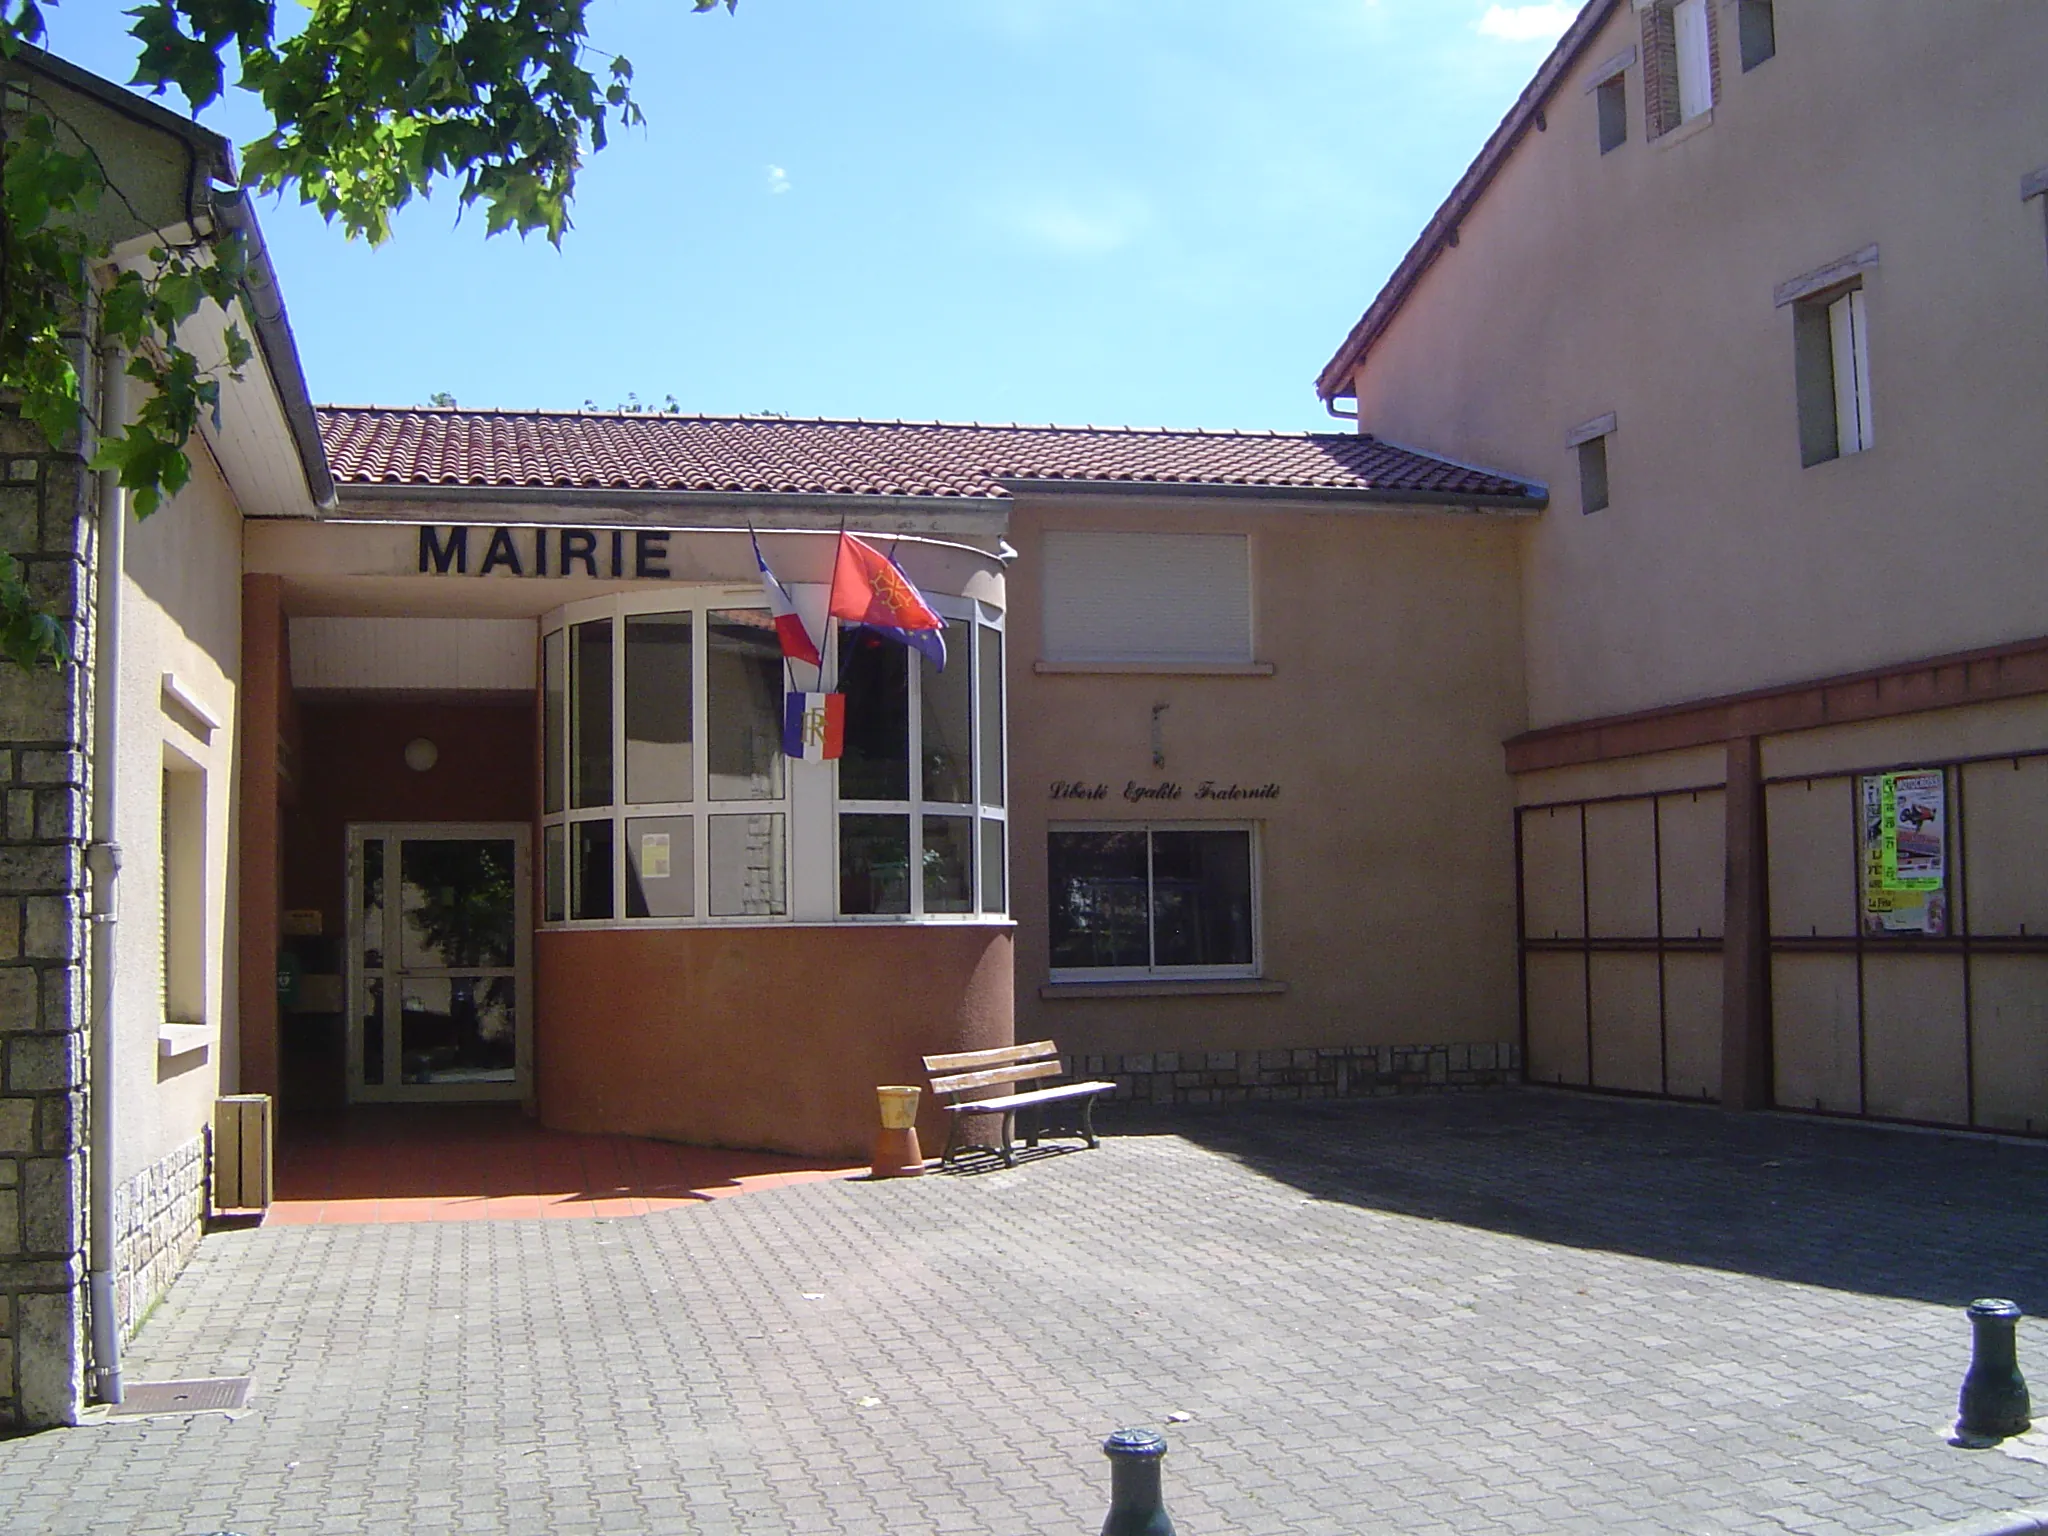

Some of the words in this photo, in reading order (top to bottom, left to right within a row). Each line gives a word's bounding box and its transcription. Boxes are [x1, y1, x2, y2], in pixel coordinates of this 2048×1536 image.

[419, 526, 671, 578] MAIRIE
[1049, 780, 1109, 800] Liberté
[1194, 780, 1281, 800] Fraternité
